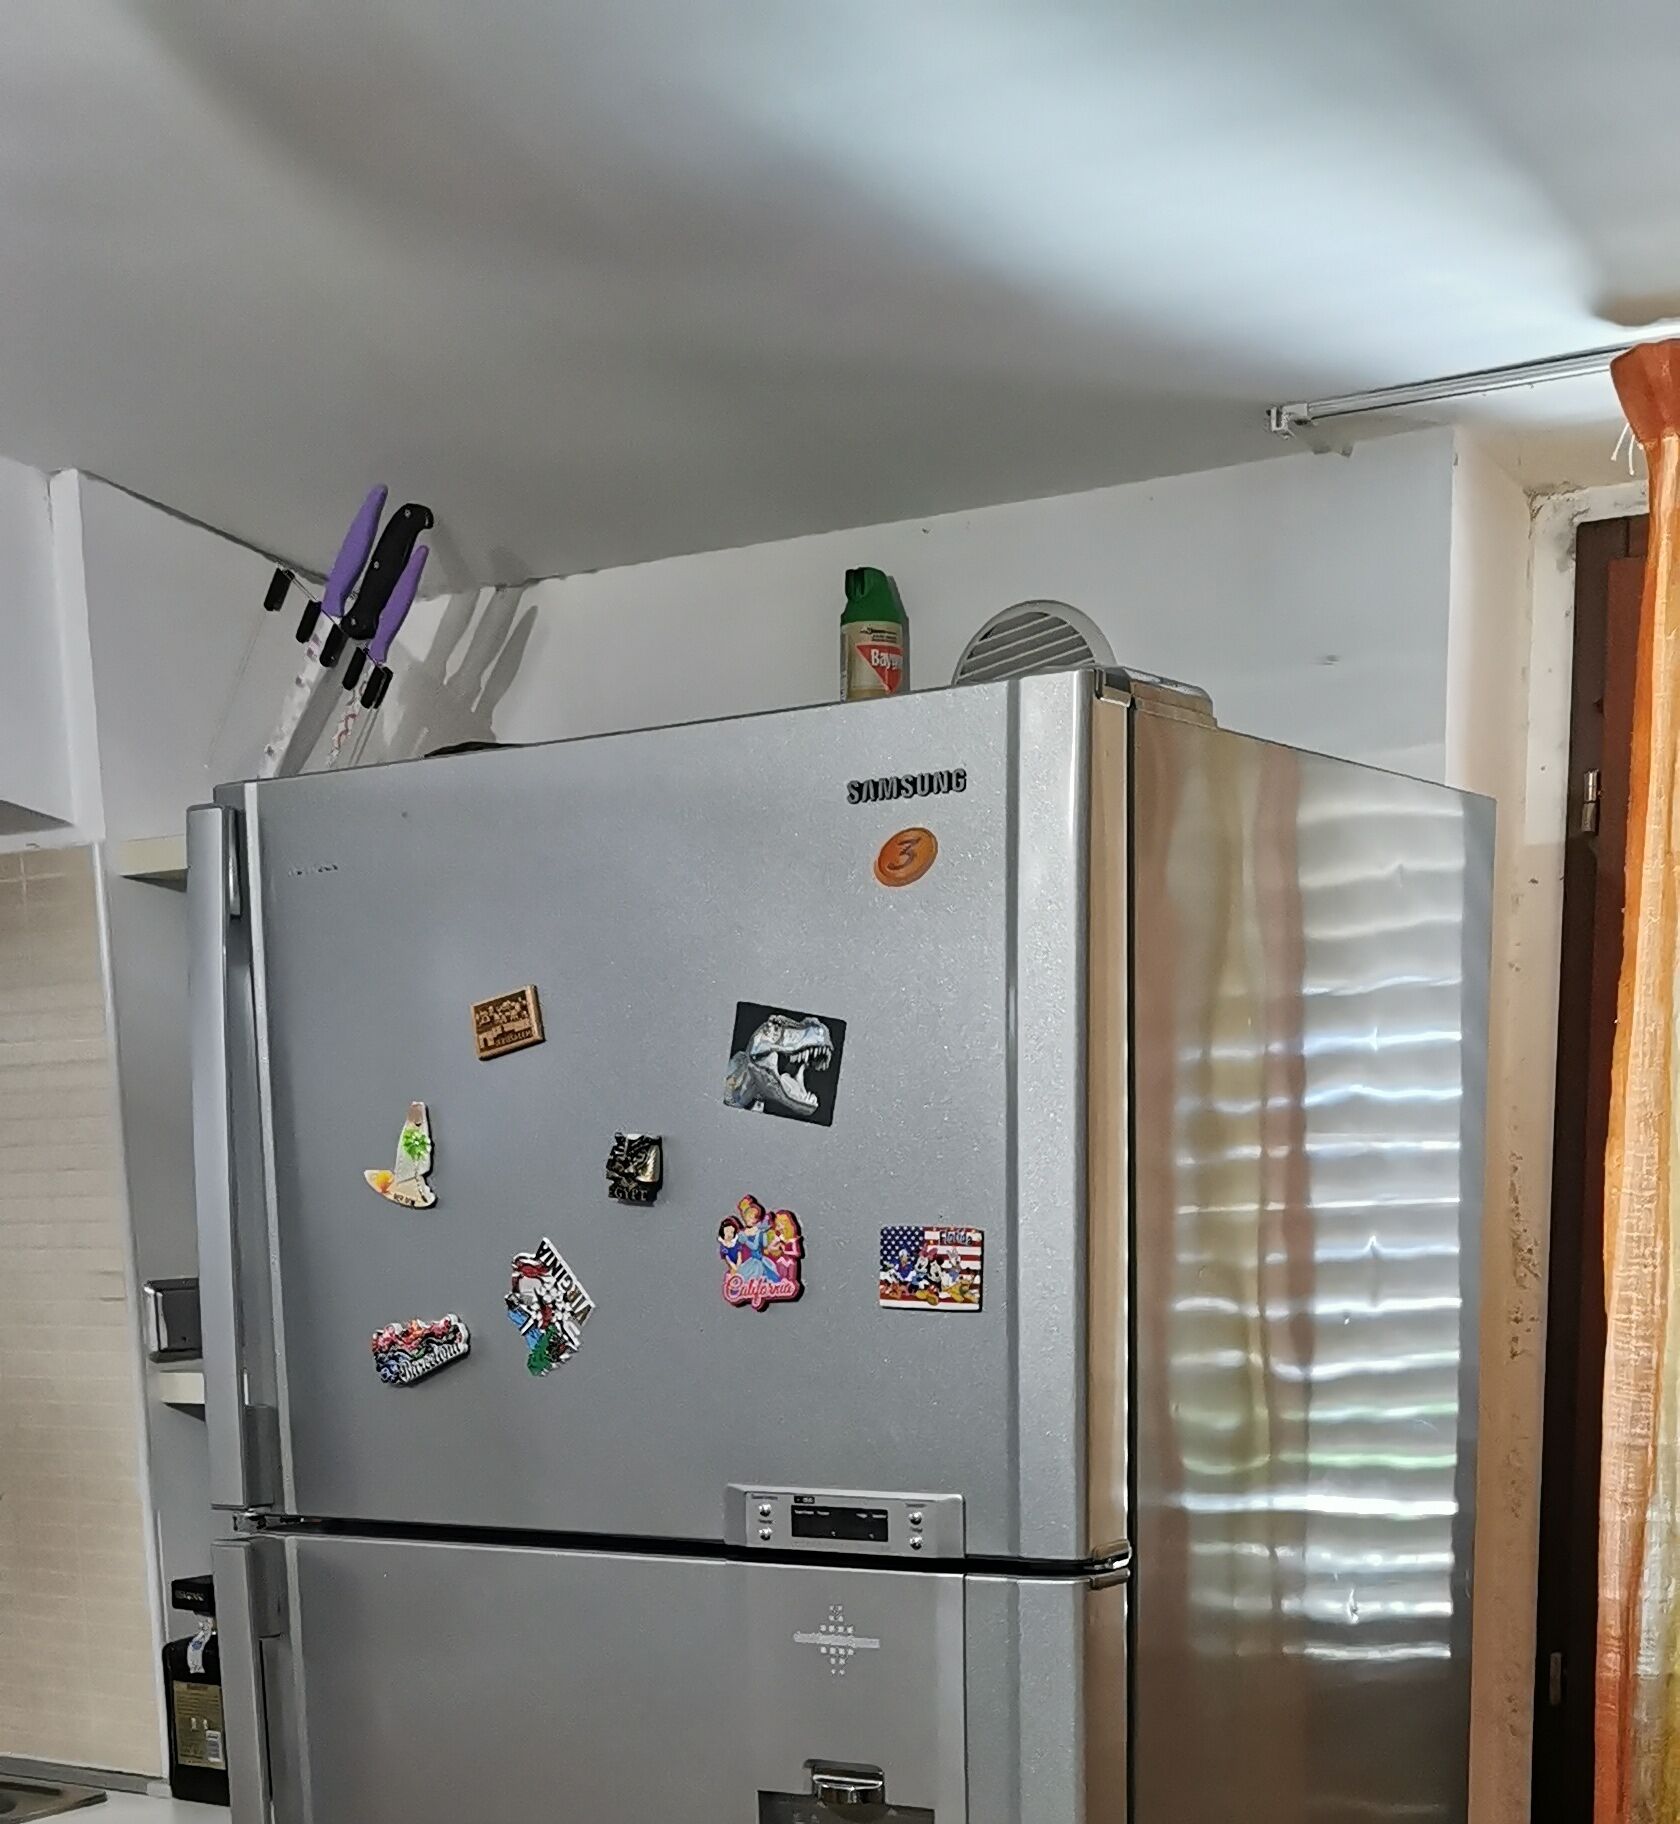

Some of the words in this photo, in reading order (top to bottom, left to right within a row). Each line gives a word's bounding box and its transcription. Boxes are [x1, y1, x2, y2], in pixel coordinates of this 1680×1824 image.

[846, 768, 967, 804] SAMSUNG
[887, 836, 922, 870] 3
[537, 1240, 593, 1326] VIRGINIA
[727, 1276, 793, 1306] California
[400, 1341, 464, 1383] Barcelona
